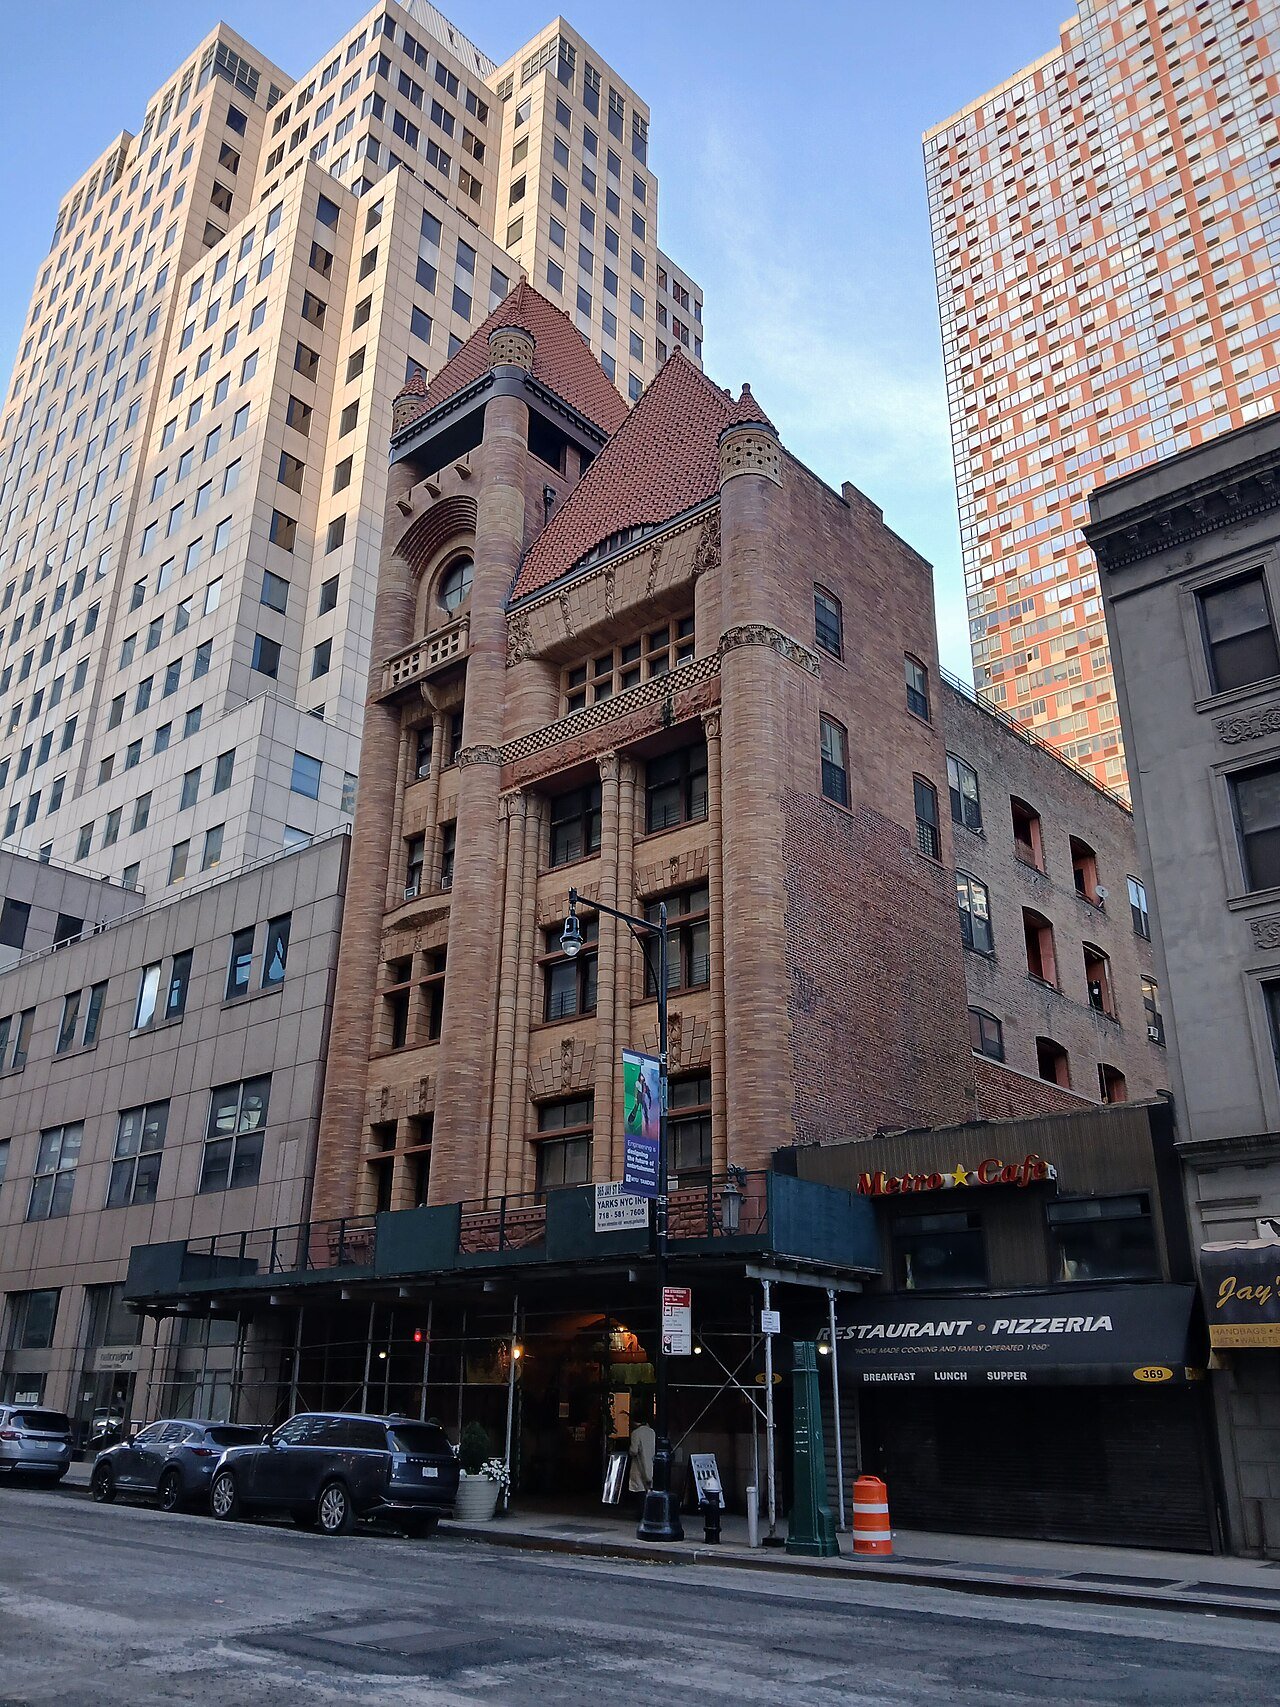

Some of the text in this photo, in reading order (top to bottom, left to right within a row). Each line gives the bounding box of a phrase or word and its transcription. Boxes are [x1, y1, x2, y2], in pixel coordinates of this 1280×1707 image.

[627, 1140, 653, 1153] Engineering
[627, 1148, 649, 1159] designing
[626, 1155, 635, 1163] the
[635, 1156, 649, 1166] future
[857, 1153, 1049, 1196] Metro Cafe
[604, 1184, 612, 1196] JAY
[612, 1184, 618, 1195] ST
[597, 1195, 647, 1209] YARKS NYC INC
[598, 1212, 609, 1220] 718
[614, 1210, 625, 1218] 581
[630, 1208, 645, 1216] 7608
[816, 1315, 1113, 1340] RESTAURANT PIZZERIA
[1213, 1327, 1267, 1336] HANDBAGS
[1214, 1335, 1279, 1344] HATS WALLETS
[900, 1346, 938, 1354] COOKING
[984, 1344, 1024, 1352] OPERATED
[862, 1370, 1028, 1382] BREAKFAST LUNCH SUPPER
[1142, 1369, 1164, 1379] 369
